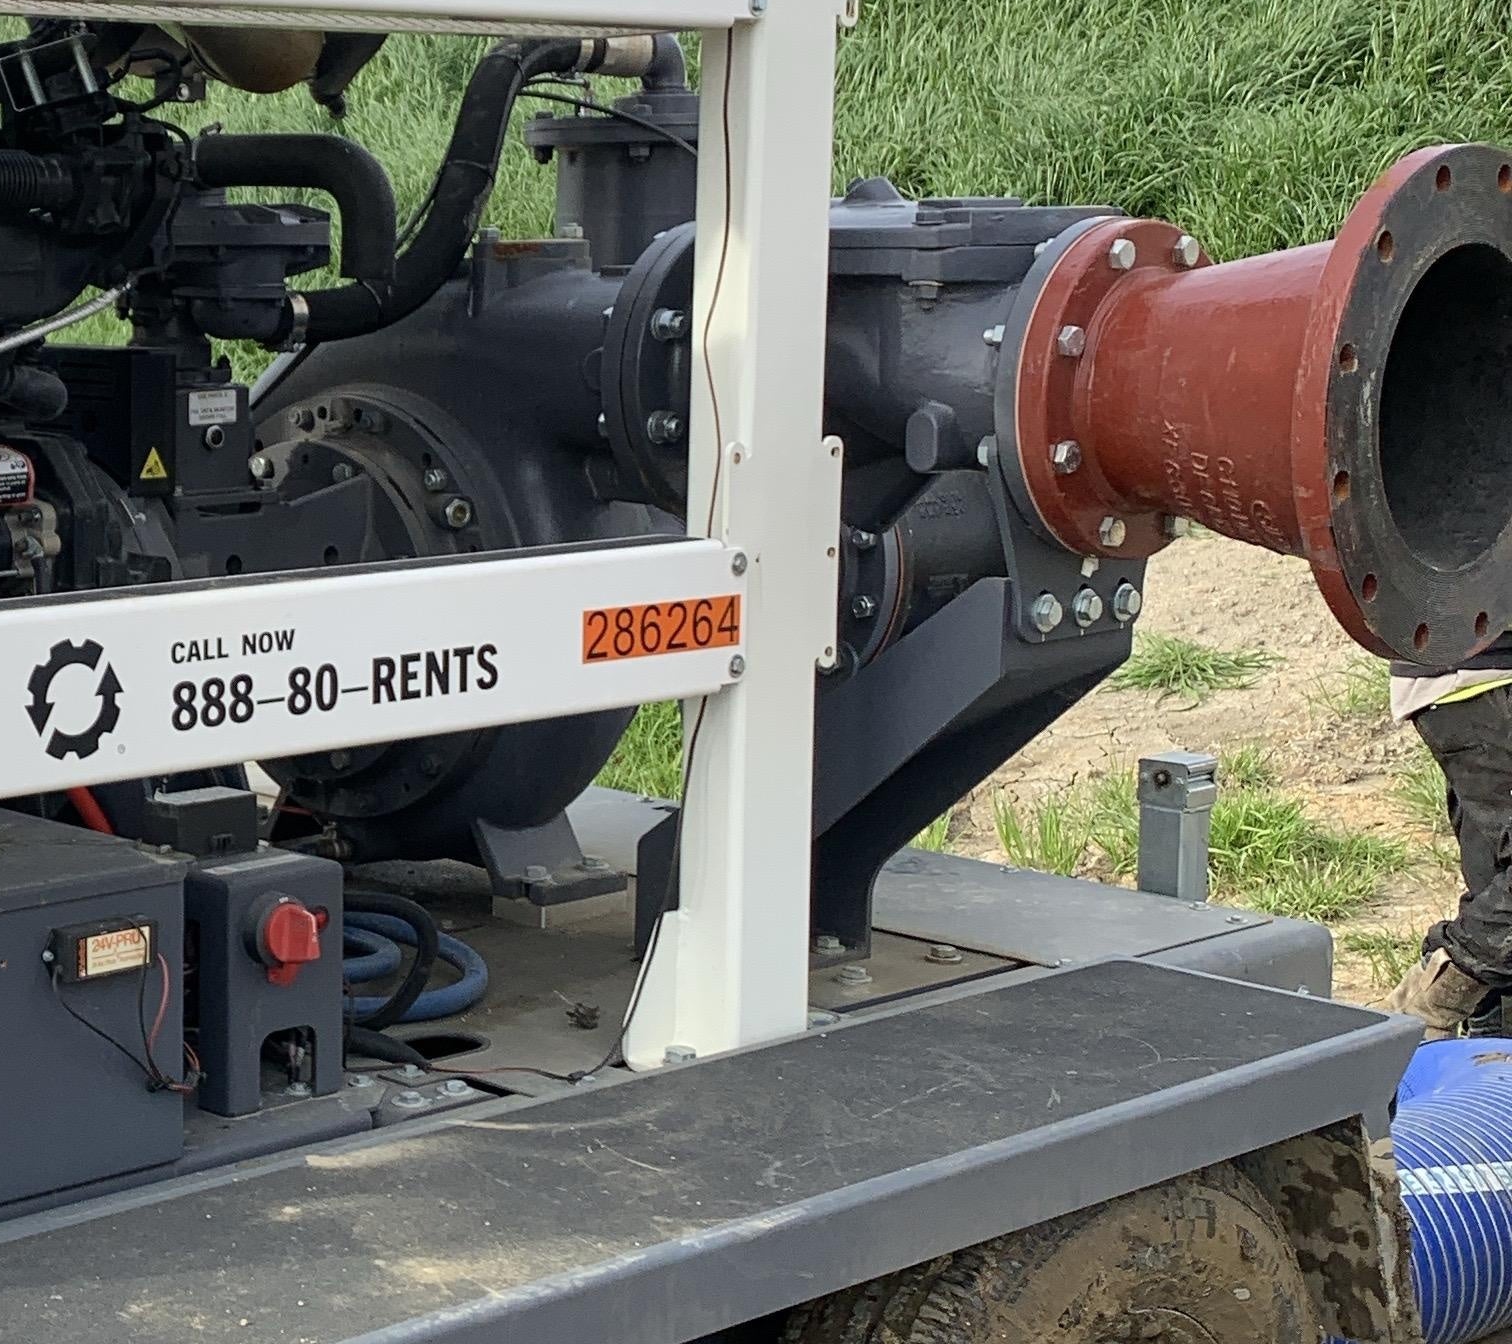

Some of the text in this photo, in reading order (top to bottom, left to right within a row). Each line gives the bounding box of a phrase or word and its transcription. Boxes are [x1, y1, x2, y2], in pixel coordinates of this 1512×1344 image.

[171, 628, 295, 664] CALL NOW
[586, 595, 738, 660] 286264
